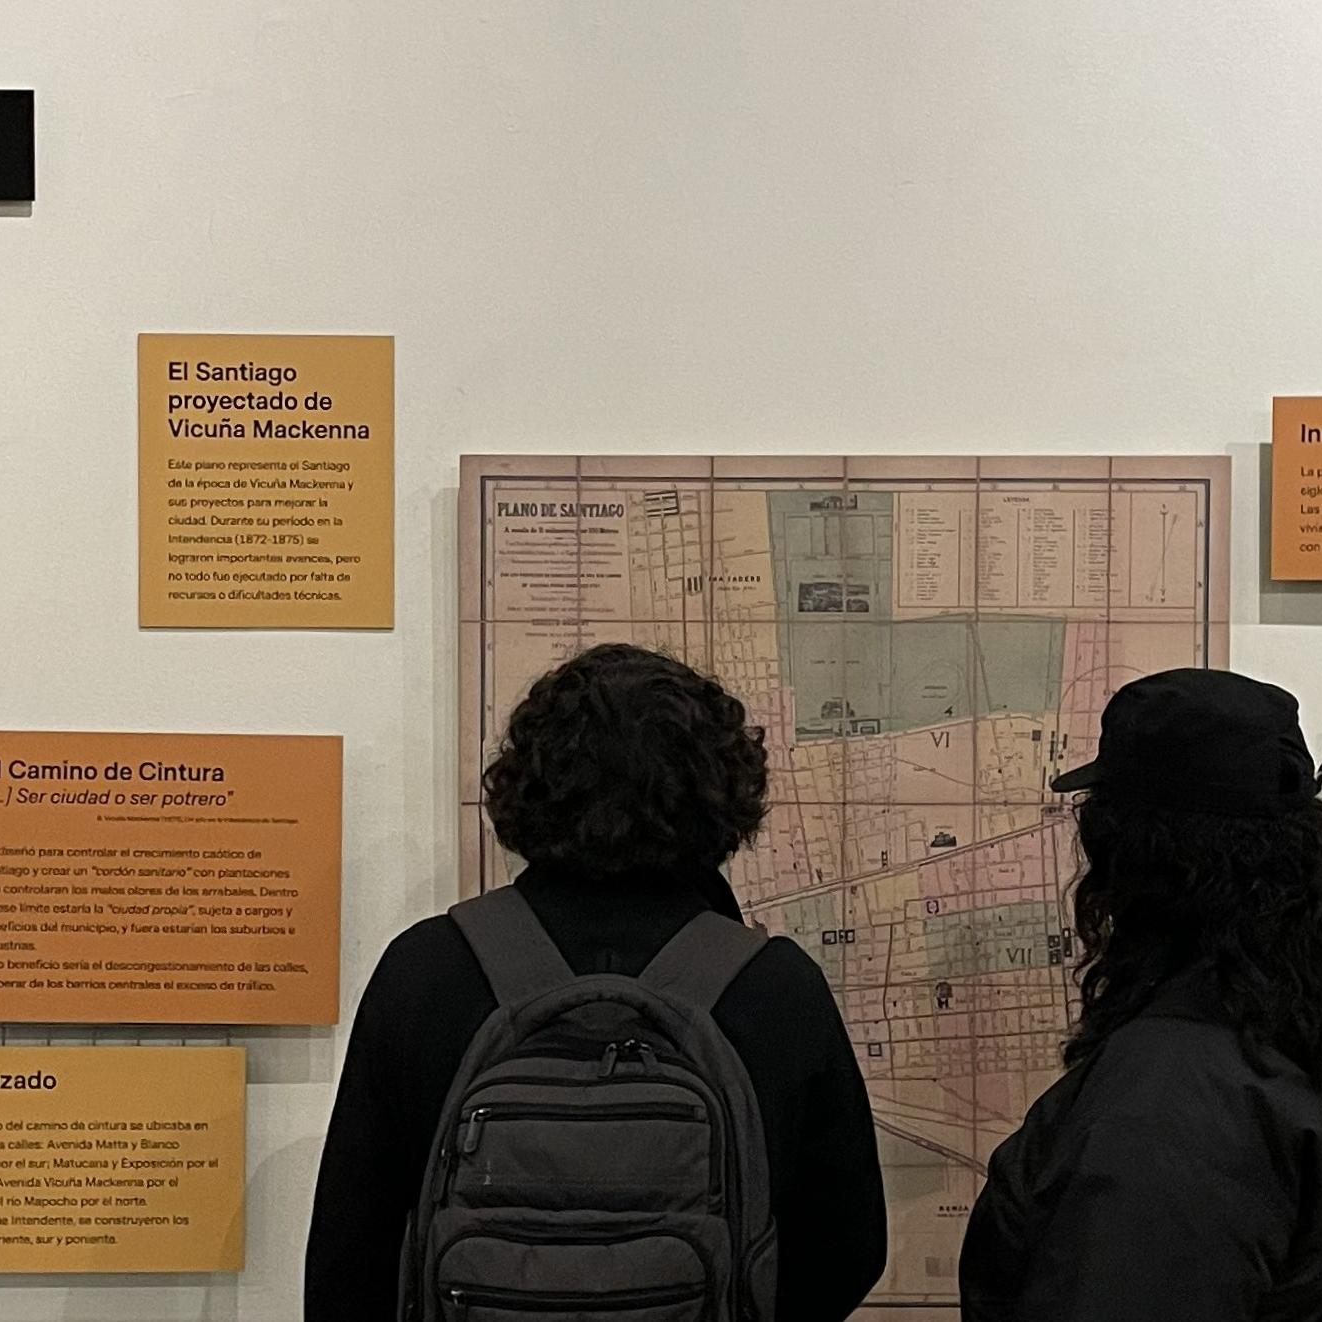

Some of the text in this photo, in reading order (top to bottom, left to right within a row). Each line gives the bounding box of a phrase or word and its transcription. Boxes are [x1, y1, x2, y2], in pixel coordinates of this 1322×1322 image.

[168, 361, 297, 386] El Santiago
[168, 390, 333, 414] proyectado de
[167, 417, 370, 440] Vicuña Mackenna
[167, 478, 354, 492] de la época de Vicuña Mackenna y
[497, 501, 625, 520] PLANO DE SANTIAGO
[168, 534, 233, 545] Intendencia
[306, 536, 320, 545] se
[930, 731, 950, 748] VI
[8, 759, 98, 781] Camino
[104, 761, 133, 781] de
[138, 761, 225, 783] Cintura
[15, 787, 48, 805] Ser
[50, 788, 112, 805] ciudad
[114, 793, 126, 806] o
[129, 793, 159, 806] ser
[1005, 947, 1032, 964] VII
[43, 1176, 83, 1188] Vicuña
[85, 1176, 145, 1188] Mackenna
[146, 1178, 167, 1190] por
[168, 1175, 180, 1188] el
